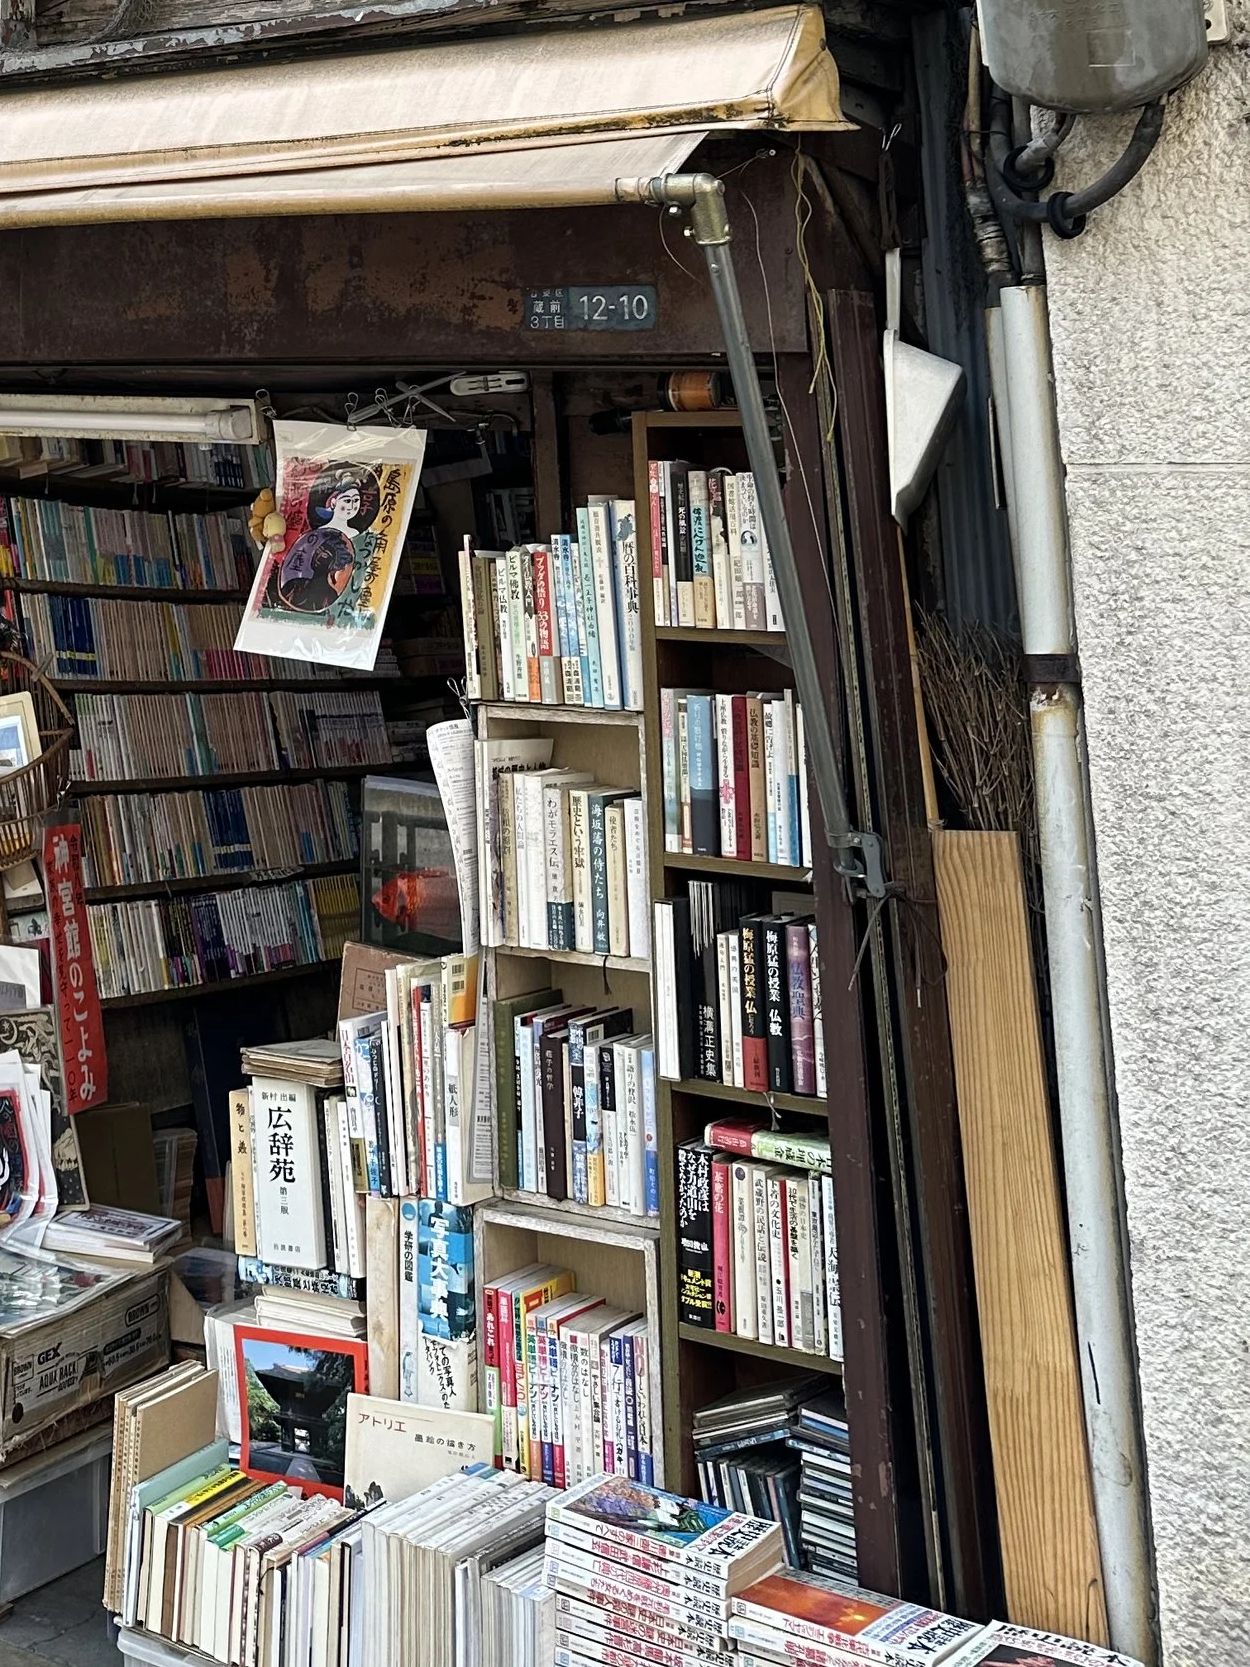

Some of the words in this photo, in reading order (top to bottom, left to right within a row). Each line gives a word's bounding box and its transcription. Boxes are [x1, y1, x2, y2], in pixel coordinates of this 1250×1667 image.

[530, 315, 565, 329] 3丁目
[533, 300, 562, 314] 蔵前
[579, 295, 649, 321] 12-10
[552, 538, 560, 561] 清水寺
[561, 538, 570, 562] 清水寺
[498, 567, 509, 614] ビルマ仏教
[535, 556, 549, 609] ブッダの悟り
[622, 541, 639, 614] 暦の百科事典
[749, 708, 760, 770] 仏教の基礎知識
[547, 797, 560, 870] わがモラエス伝
[571, 795, 585, 870] 歴史という牢獄
[591, 803, 605, 900] 海坂藩の侍たち
[69, 834, 85, 909] 令和八年
[52, 833, 97, 1103] 神宮館のこよみ
[742, 927, 756, 1000] 梅原猛の授業
[766, 930, 782, 1003] 梅原猛の授業
[790, 963, 806, 1021] 仏教聖典
[703, 1005, 718, 1078] 横溝正史集
[768, 1008, 783, 1037] 仏教
[261, 1091, 278, 1101] 新村
[447, 1083, 459, 1119] 紙人形
[267, 1106, 296, 1184] 広辞苑
[279, 1186, 290, 1215] 第三版
[678, 1149, 689, 1229] 殺さなかったのか
[687, 1151, 697, 1221] なぜ力道山を
[698, 1153, 710, 1213] 木村政彦は
[753, 1178, 768, 1264] 武蔵野の民話と伝説
[769, 1180, 782, 1240] 下着の文化史
[273, 1243, 301, 1253] 岩波書店
[403, 1231, 414, 1283] 学研の図鑑
[430, 1217, 451, 1322] 写真大事典
[128, 1301, 151, 1323] BROWN
[13, 1361, 33, 1377] BROWN
[37, 1341, 63, 1366] GEX
[579, 1347, 590, 1398] 数のはなし
[39, 1370, 58, 1391] AQUA
[58, 1360, 78, 1381] RACK
[439, 1346, 457, 1402] ての写真人
[569, 1344, 579, 1403] 微積分のはなし
[358, 1412, 407, 1434] アトリエ
[414, 1433, 477, 1453] 墨絵の描き方
[595, 1523, 668, 1555] 徳川御三家のすべて
[706, 1519, 775, 1559] 歴史読本
[685, 1554, 722, 1575] 歴史読本
[683, 1574, 722, 1597] 歴史読本
[683, 1593, 721, 1616] 歴史読本
[656, 1632, 684, 1651] 日本史
[678, 1624, 715, 1648] 歴史読本
[685, 1612, 723, 1635] 歴史読本
[906, 1617, 976, 1656] 歴史読本
[697, 1644, 735, 1667] 歴史読本
